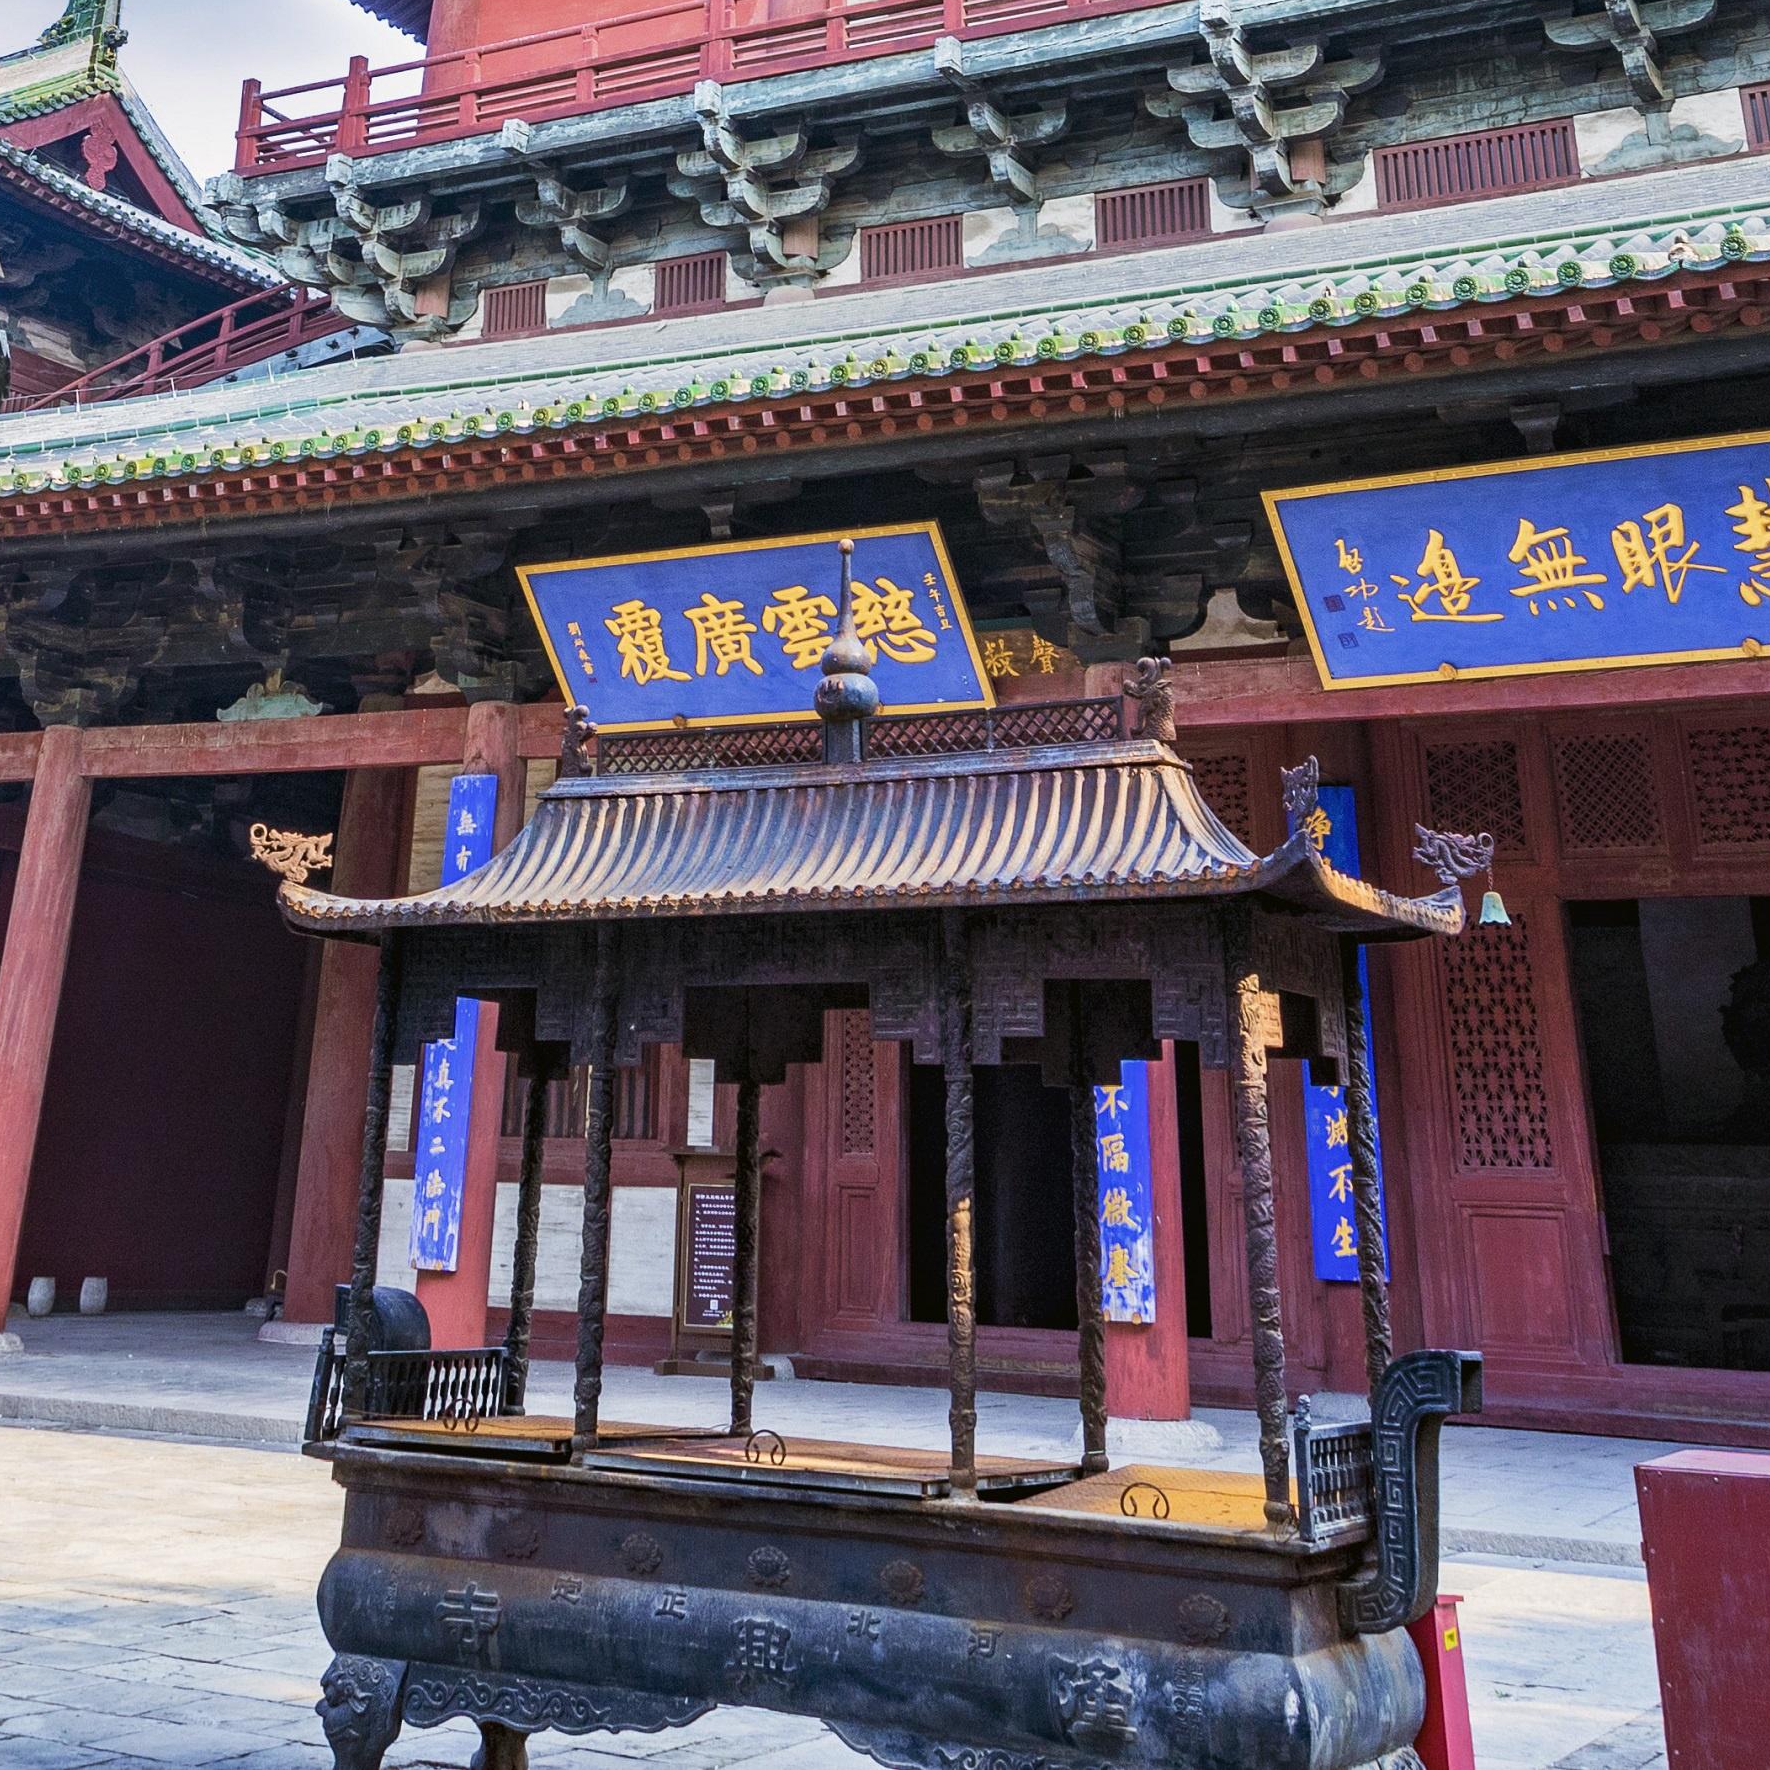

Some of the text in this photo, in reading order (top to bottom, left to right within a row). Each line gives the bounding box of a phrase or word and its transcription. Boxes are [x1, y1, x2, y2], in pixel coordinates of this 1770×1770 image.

[604, 576, 938, 686] 慈雲廣覆
[422, 1038, 456, 1243] 真不二法門
[1321, 1086, 1358, 1258] 滅不生
